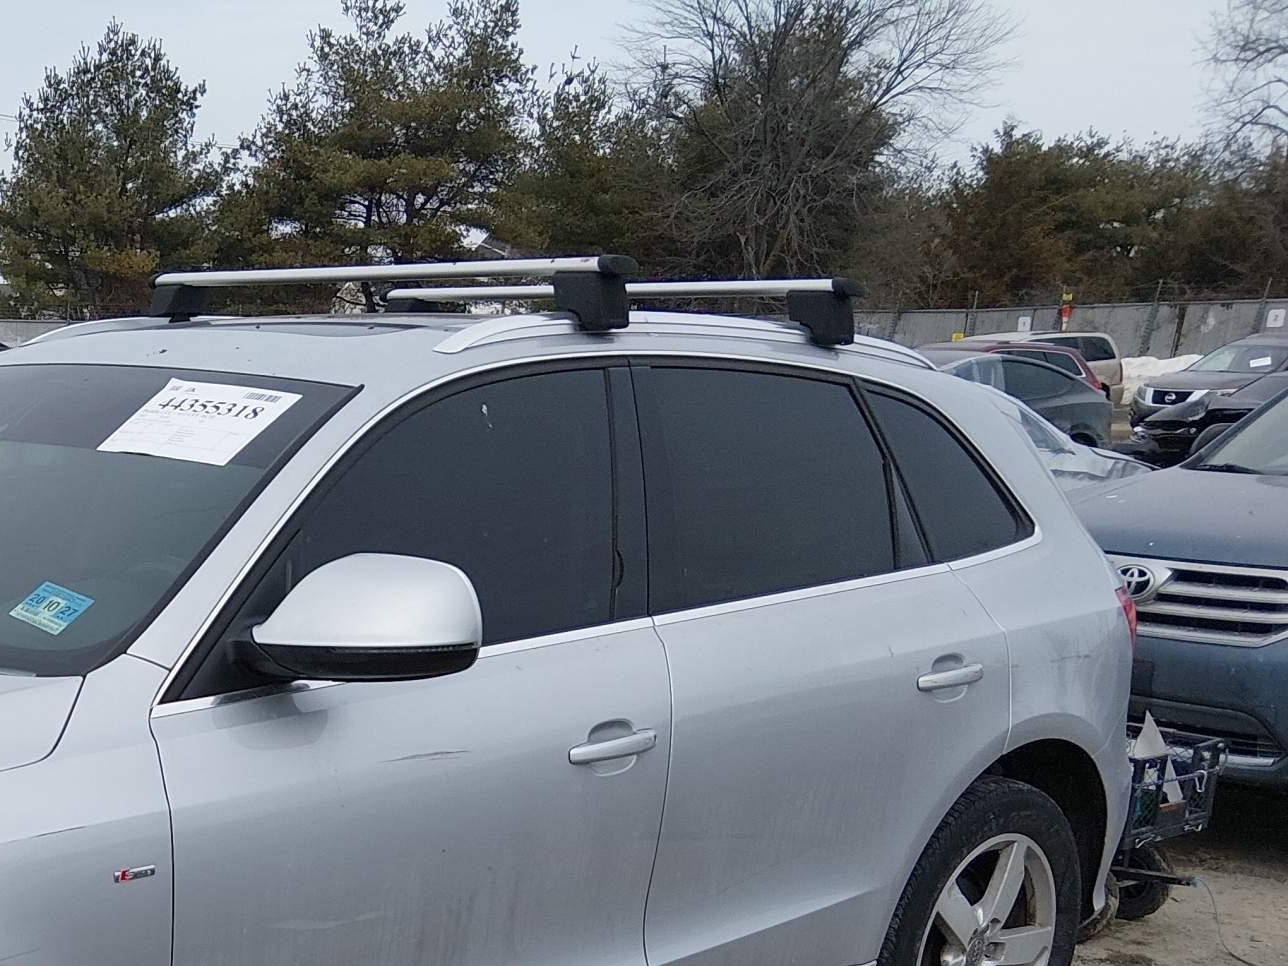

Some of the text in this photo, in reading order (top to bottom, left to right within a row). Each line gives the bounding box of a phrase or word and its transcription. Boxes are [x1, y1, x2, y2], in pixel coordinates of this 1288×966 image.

[158, 397, 264, 420] 44355318
[29, 593, 46, 605] 20
[43, 600, 60, 612] 10
[60, 606, 79, 617] 27
